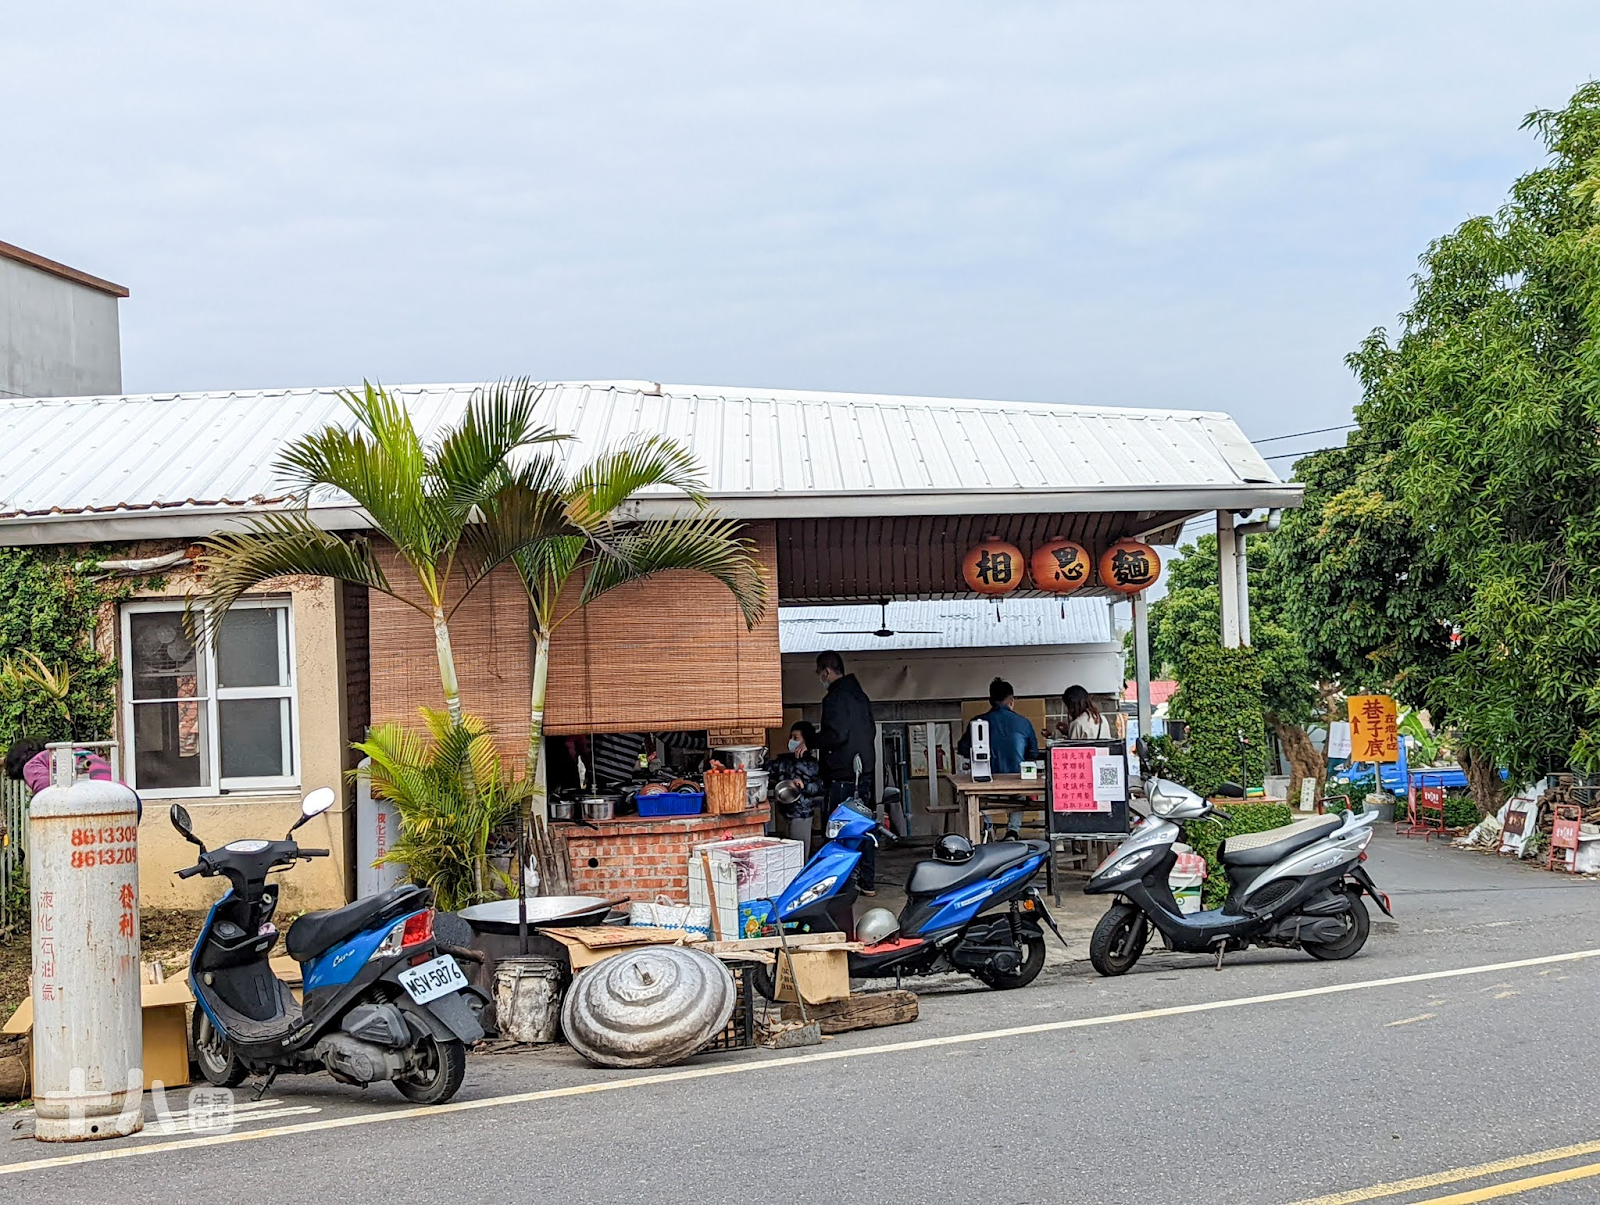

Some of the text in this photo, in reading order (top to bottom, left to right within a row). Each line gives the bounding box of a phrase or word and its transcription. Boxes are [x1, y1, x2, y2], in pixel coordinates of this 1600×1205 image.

[975, 547, 1153, 587] 相思麵
[1361, 699, 1385, 756] 巷子底
[1385, 713, 1397, 750] 在地小吃
[71, 826, 137, 847] 8613309
[71, 848, 137, 868] 8613209
[40, 890, 55, 1001] 液化石油氣
[405, 963, 462, 998] MSV-5876
